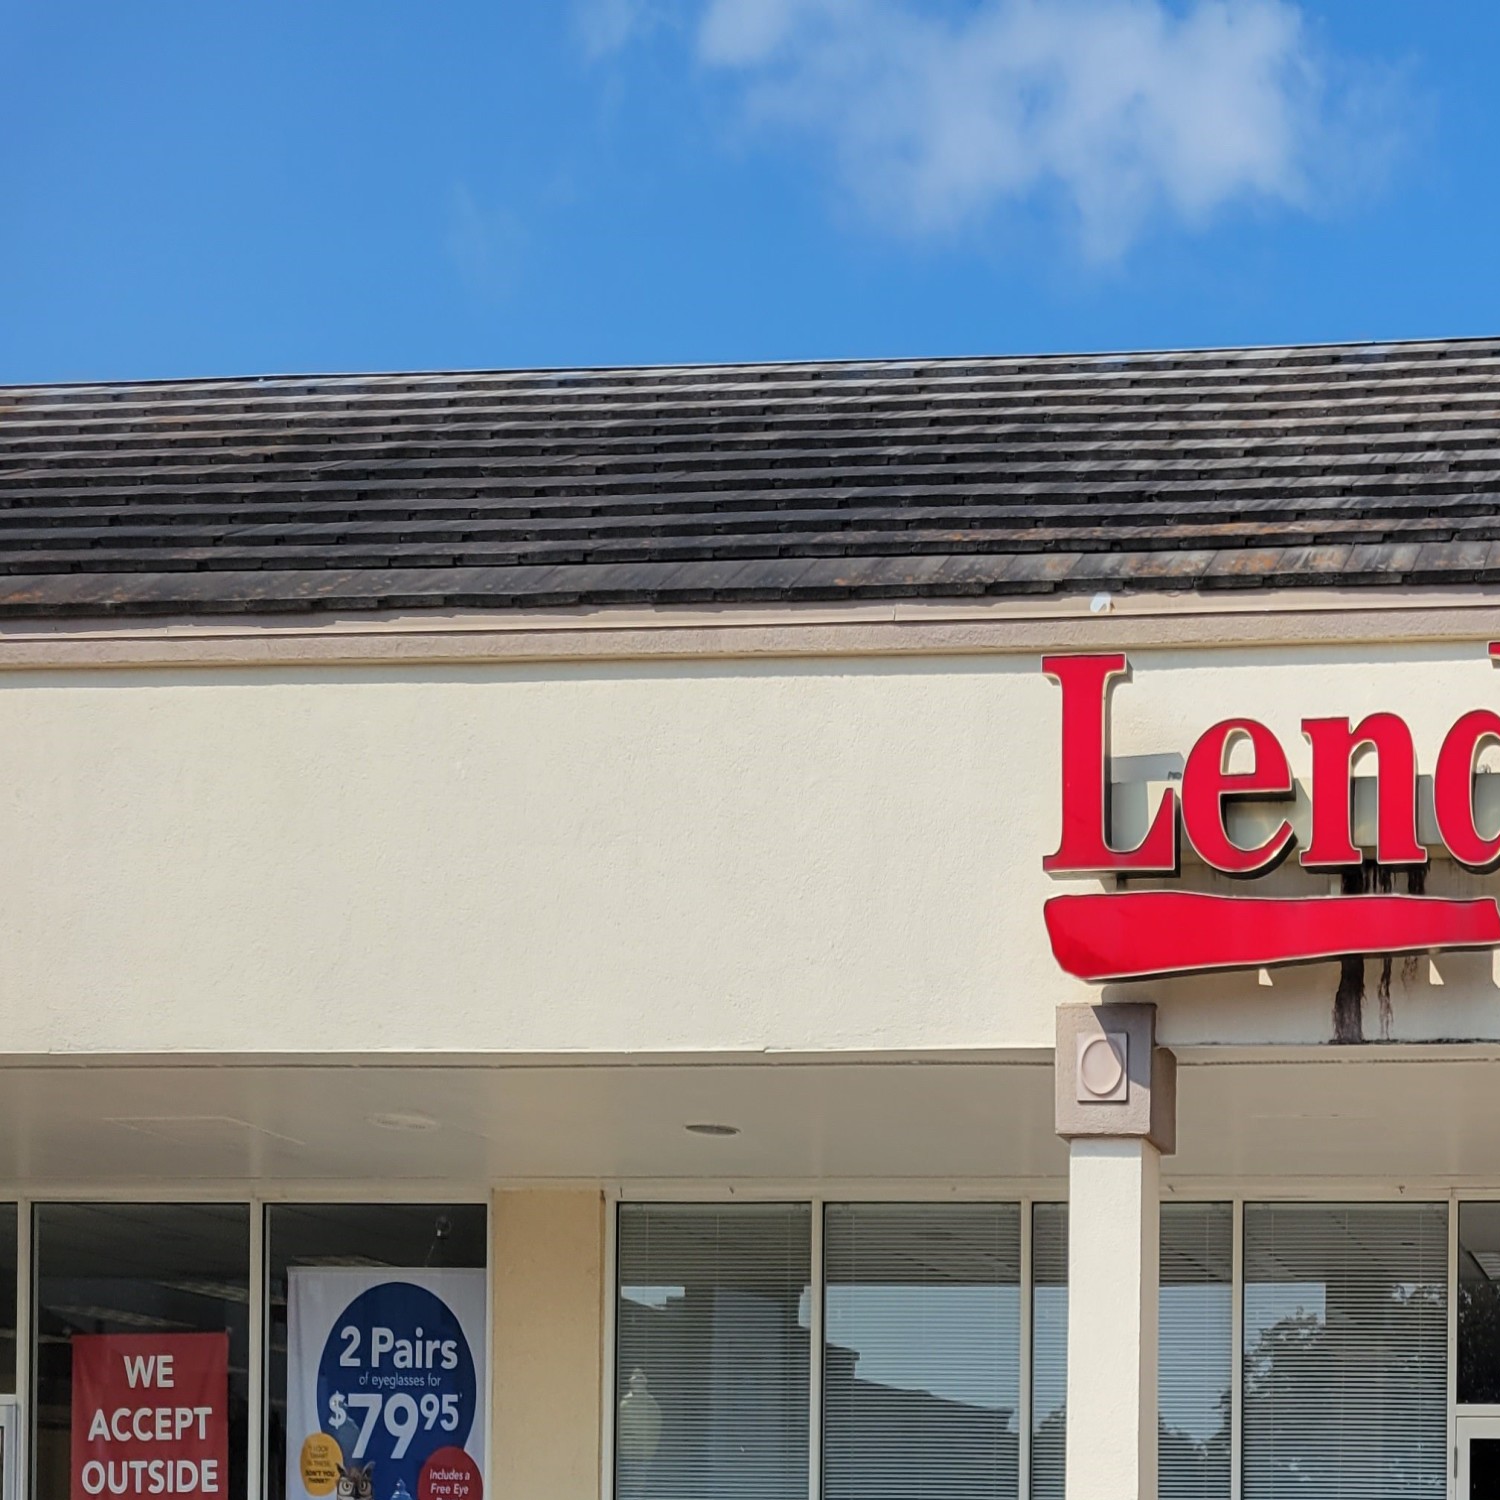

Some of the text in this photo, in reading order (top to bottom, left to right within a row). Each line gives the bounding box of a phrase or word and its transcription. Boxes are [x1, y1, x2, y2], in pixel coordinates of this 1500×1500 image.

[339, 1325, 459, 1370] 2 Pairs
[123, 1354, 175, 1389] WE
[358, 1371, 442, 1390] of eyeglasses for
[87, 1406, 213, 1442] ACCEPT
[81, 1458, 219, 1495] OUTSIDE
[429, 1468, 471, 1480] Includes a
[430, 1482, 469, 1498] Free Eye
